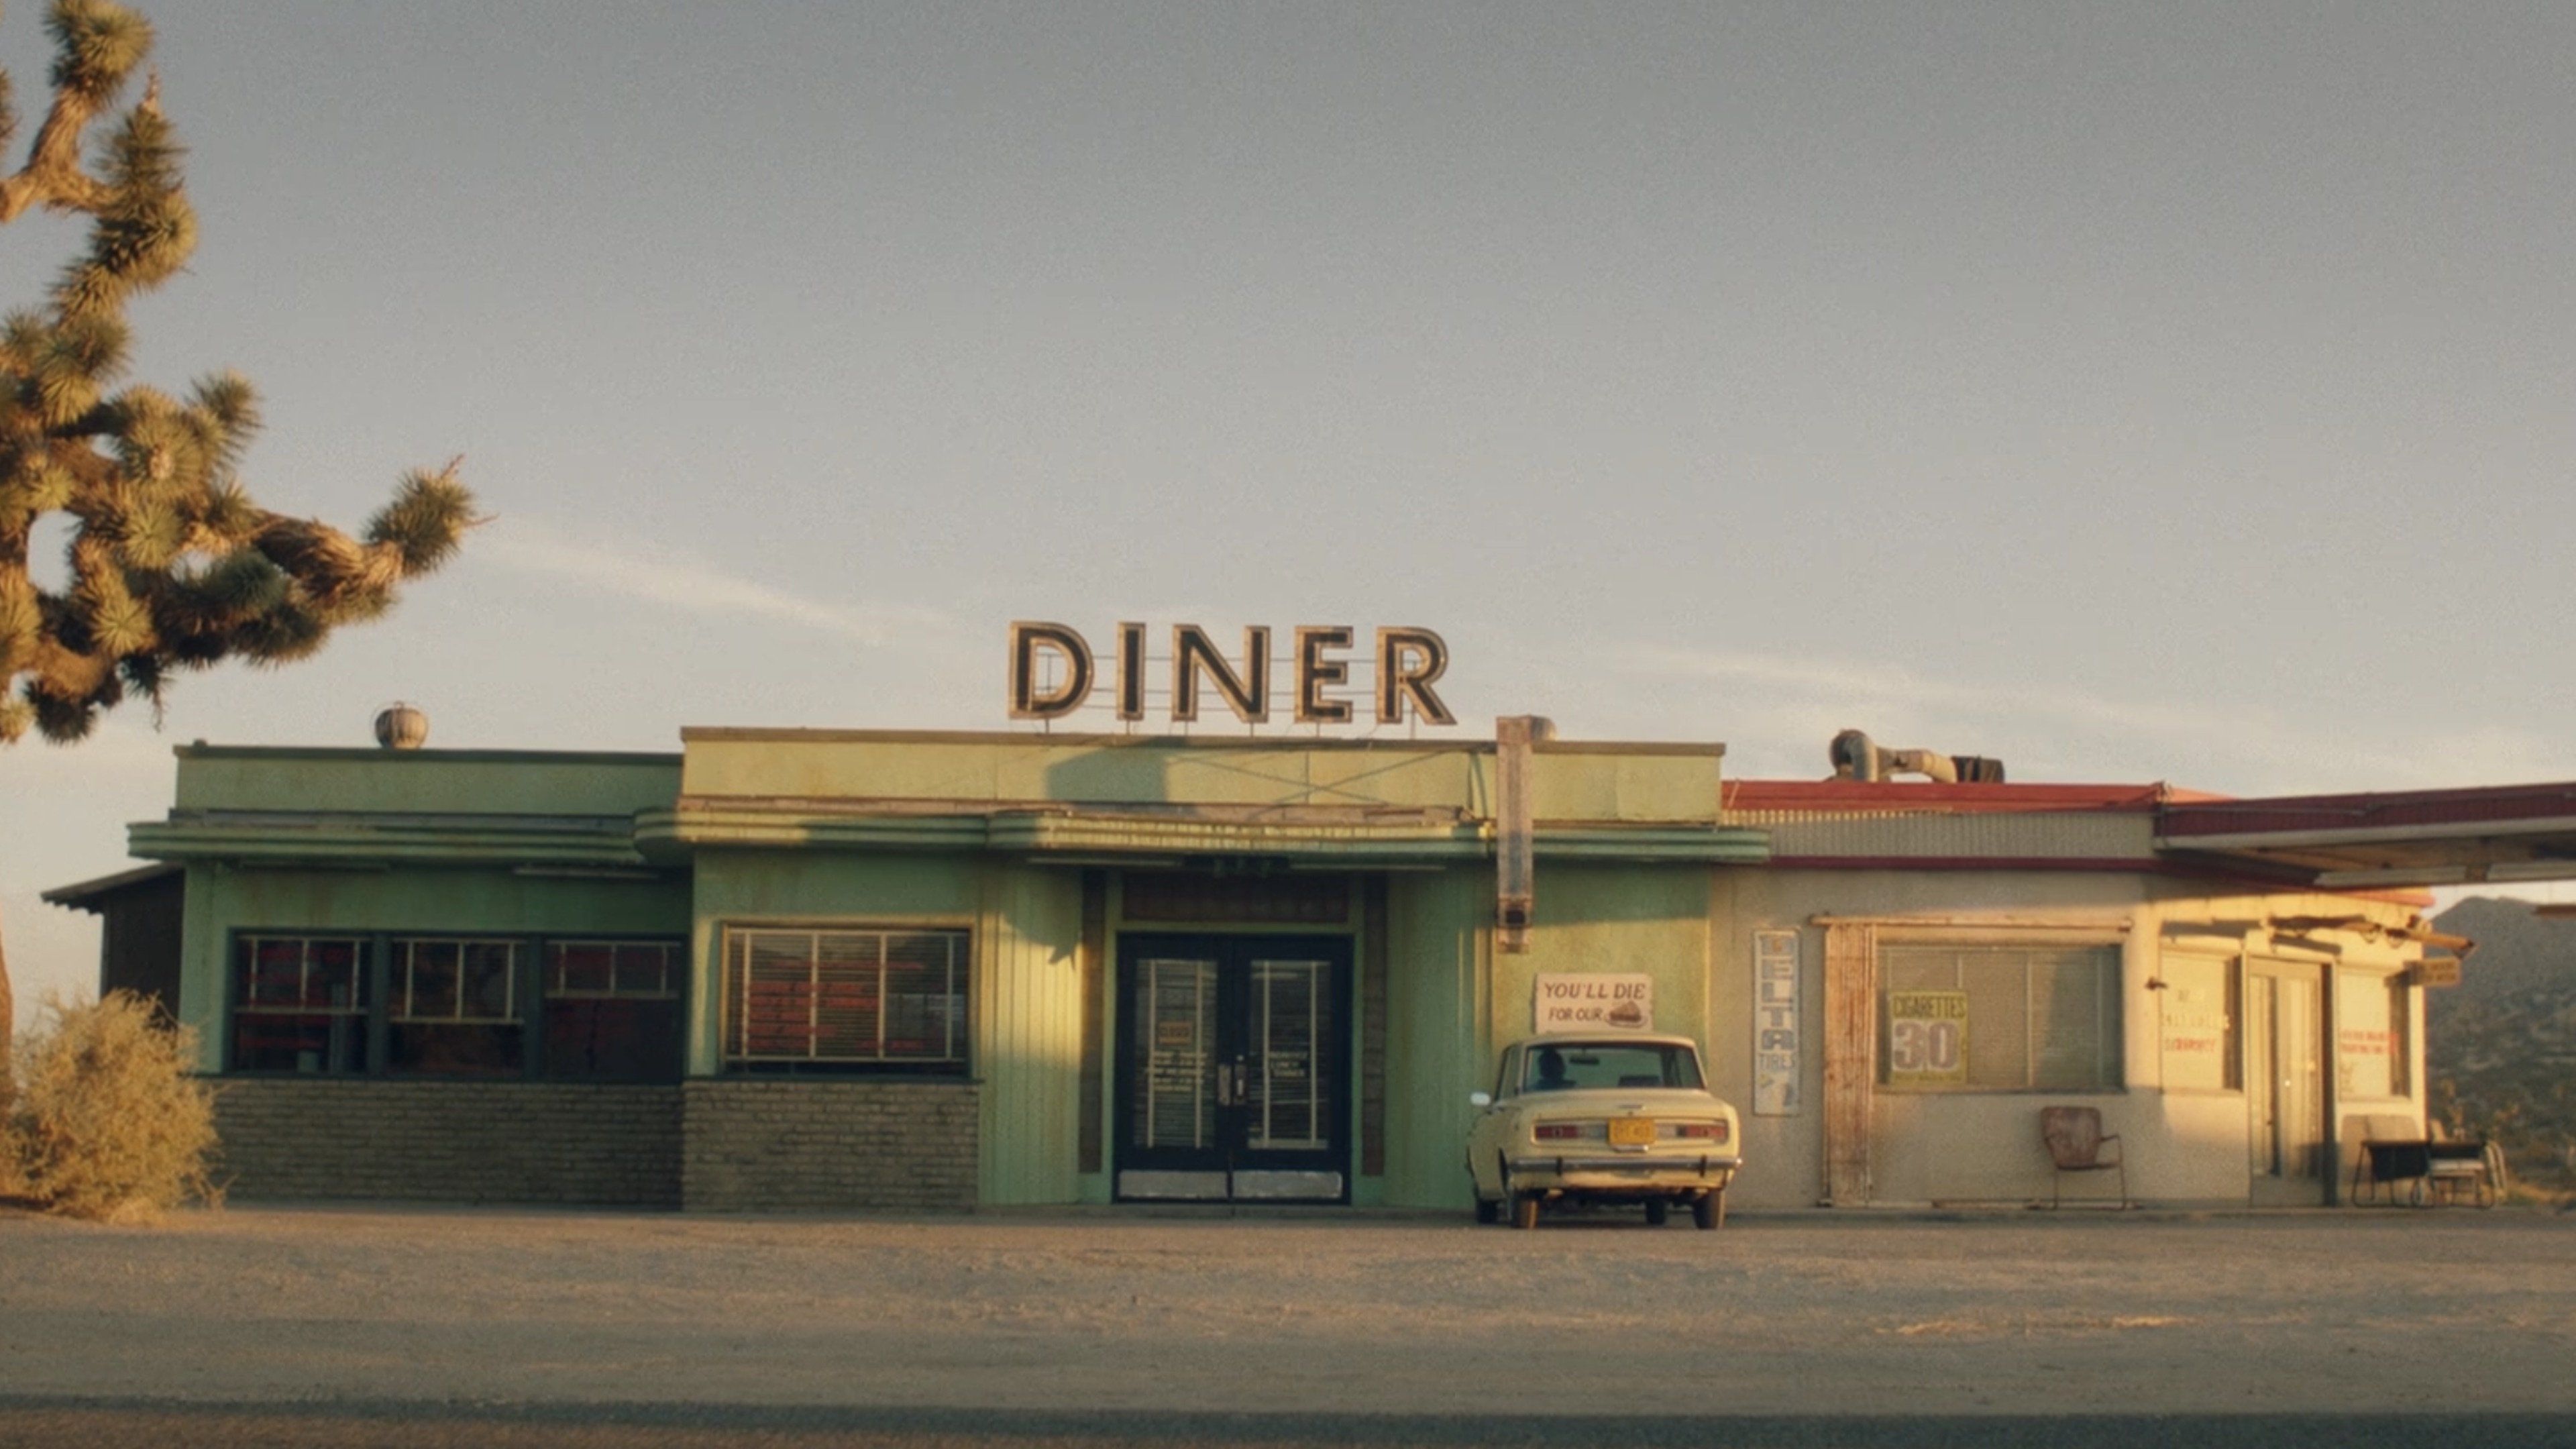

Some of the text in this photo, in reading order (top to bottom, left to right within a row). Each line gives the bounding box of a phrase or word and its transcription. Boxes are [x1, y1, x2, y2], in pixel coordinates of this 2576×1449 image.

[1008, 621, 1458, 726] DINER
[1544, 982, 1646, 1000] YOU'LL DIE
[1548, 1007, 1603, 1022] FOR OUR
[1893, 995, 1966, 1018] CIGARETTES
[1894, 1021, 1959, 1070] 30
